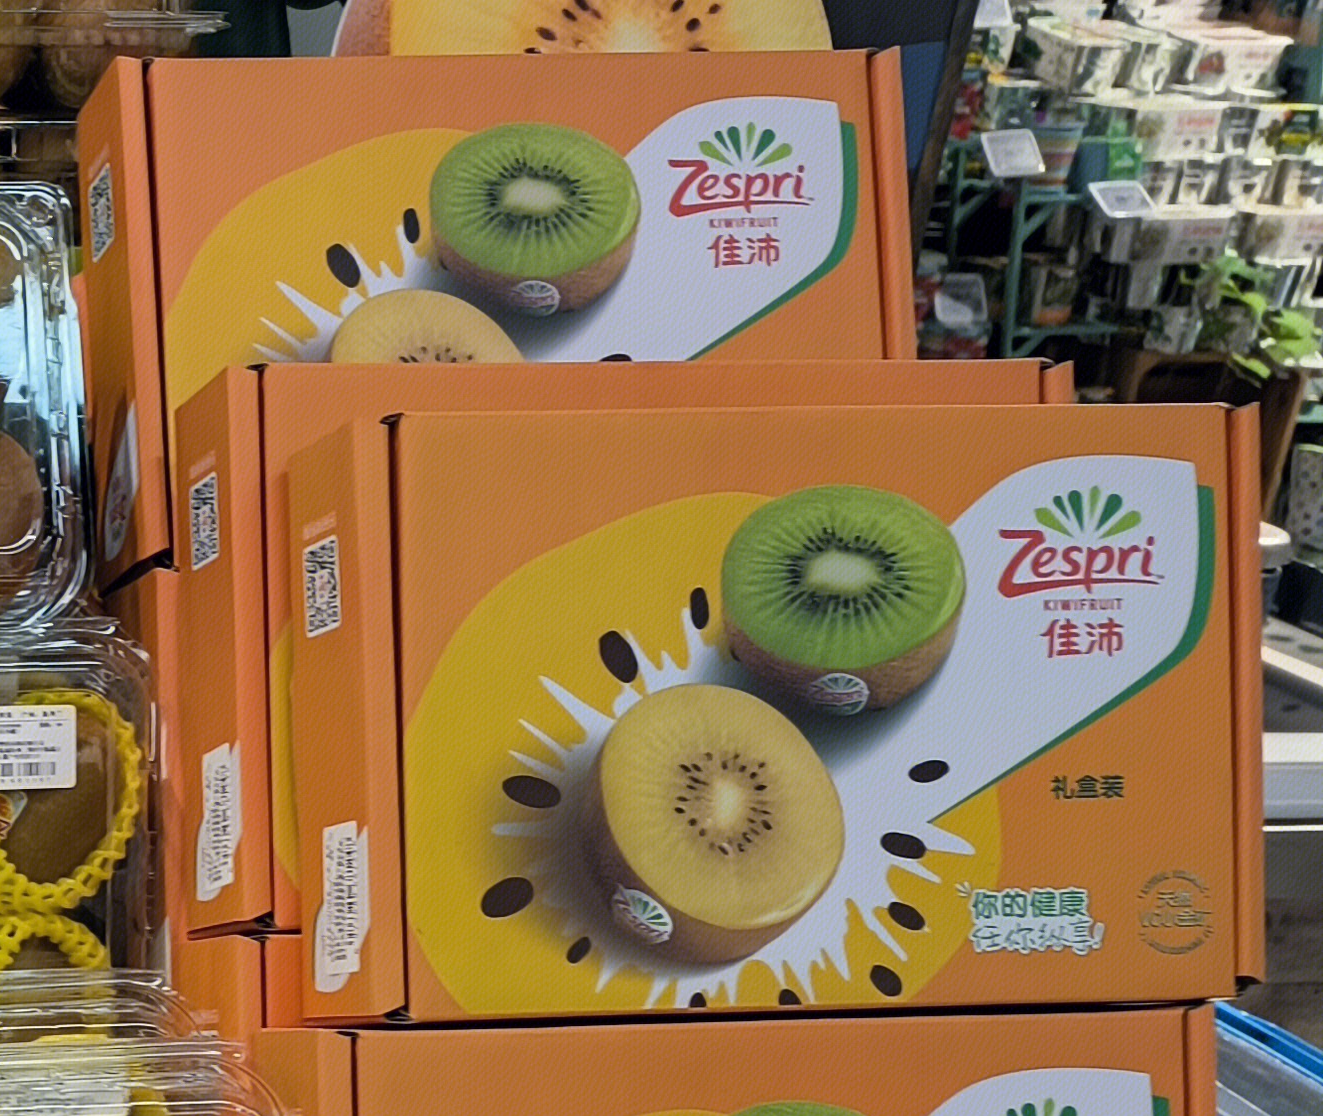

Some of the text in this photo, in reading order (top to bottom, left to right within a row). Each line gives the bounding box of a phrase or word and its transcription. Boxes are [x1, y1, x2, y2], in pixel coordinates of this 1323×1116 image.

[667, 159, 815, 216] Zespri
[708, 216, 779, 229] KIWIFRUIT
[707, 233, 782, 269] 佳沛
[997, 528, 1165, 597] Zespri
[1043, 598, 1124, 611] KIWIFRUIT
[1040, 617, 1126, 659] 佳沛
[1051, 775, 1125, 800] 礼盒装
[971, 889, 1087, 920] 你的健康
